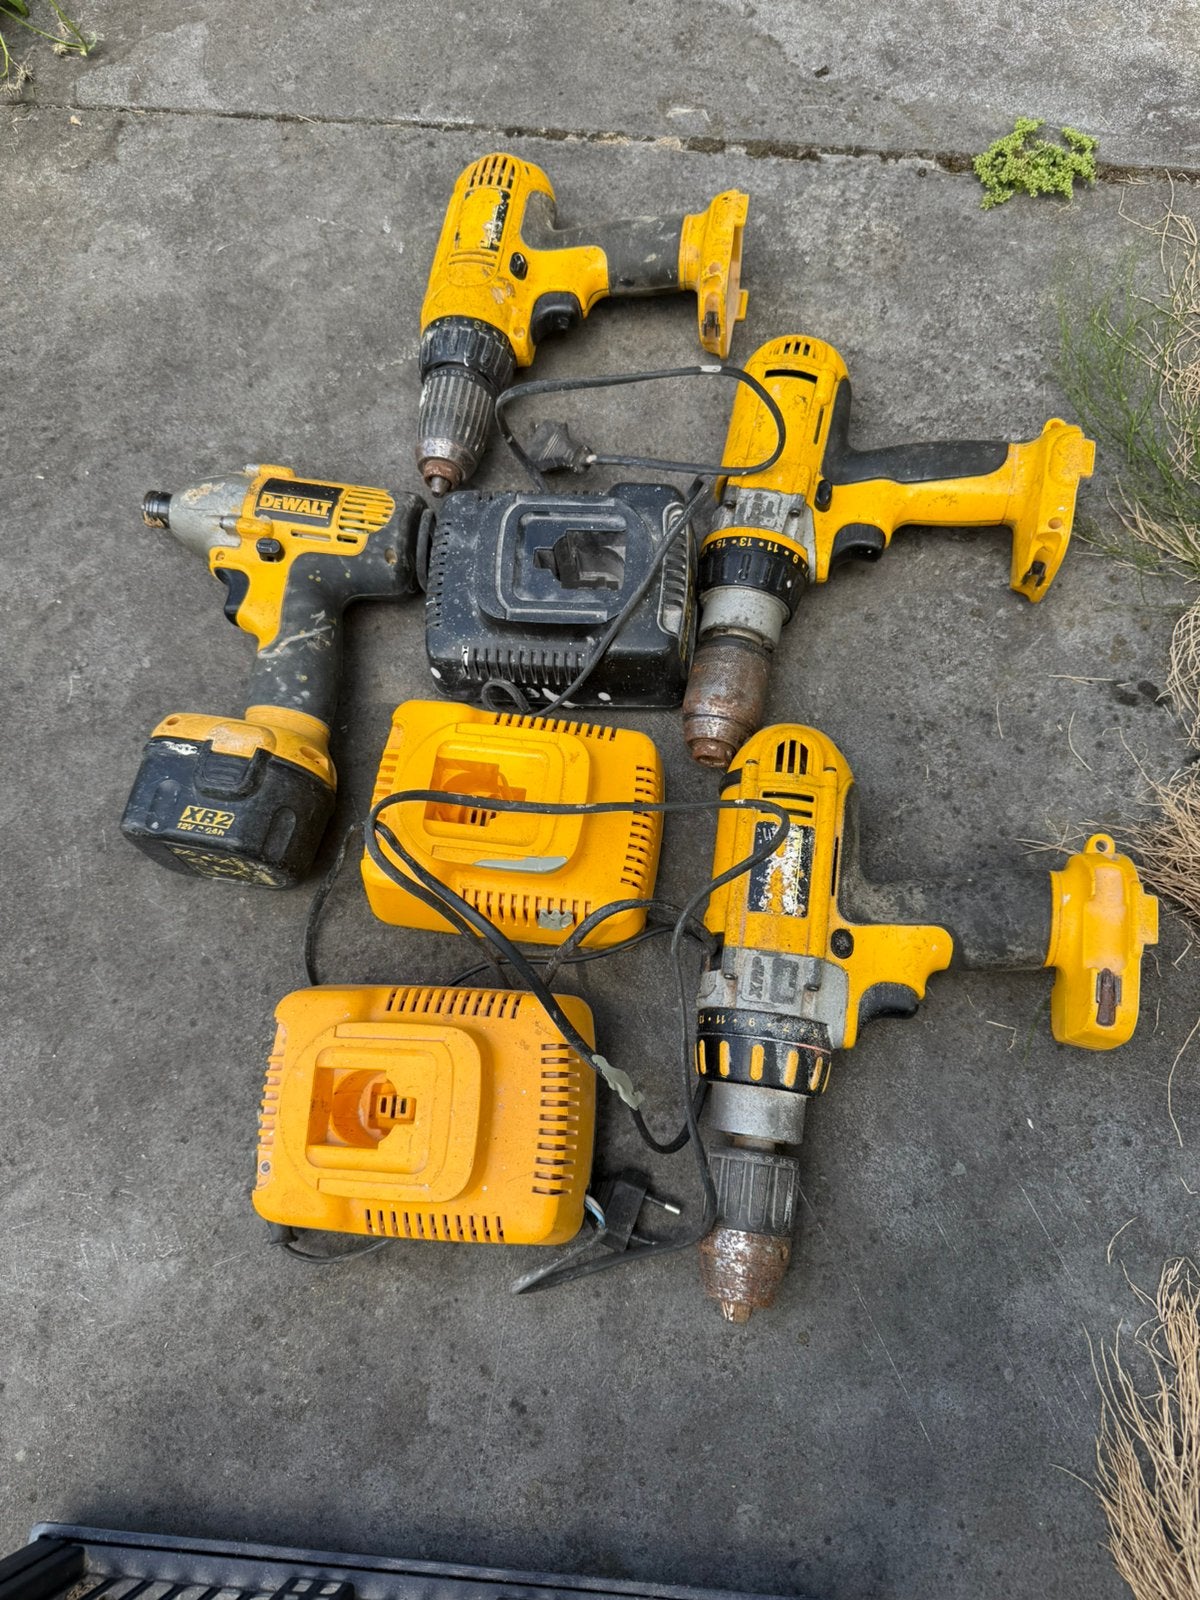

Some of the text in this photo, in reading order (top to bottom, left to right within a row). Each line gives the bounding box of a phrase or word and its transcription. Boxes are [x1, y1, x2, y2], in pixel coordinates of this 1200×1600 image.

[716, 538, 727, 549] 15
[739, 537, 752, 547] 13
[767, 541, 779, 553] 11
[181, 806, 235, 828] XR2
[177, 822, 195, 832] 12V
[716, 1014, 726, 1025] 11
[748, 1017, 756, 1027] 9
